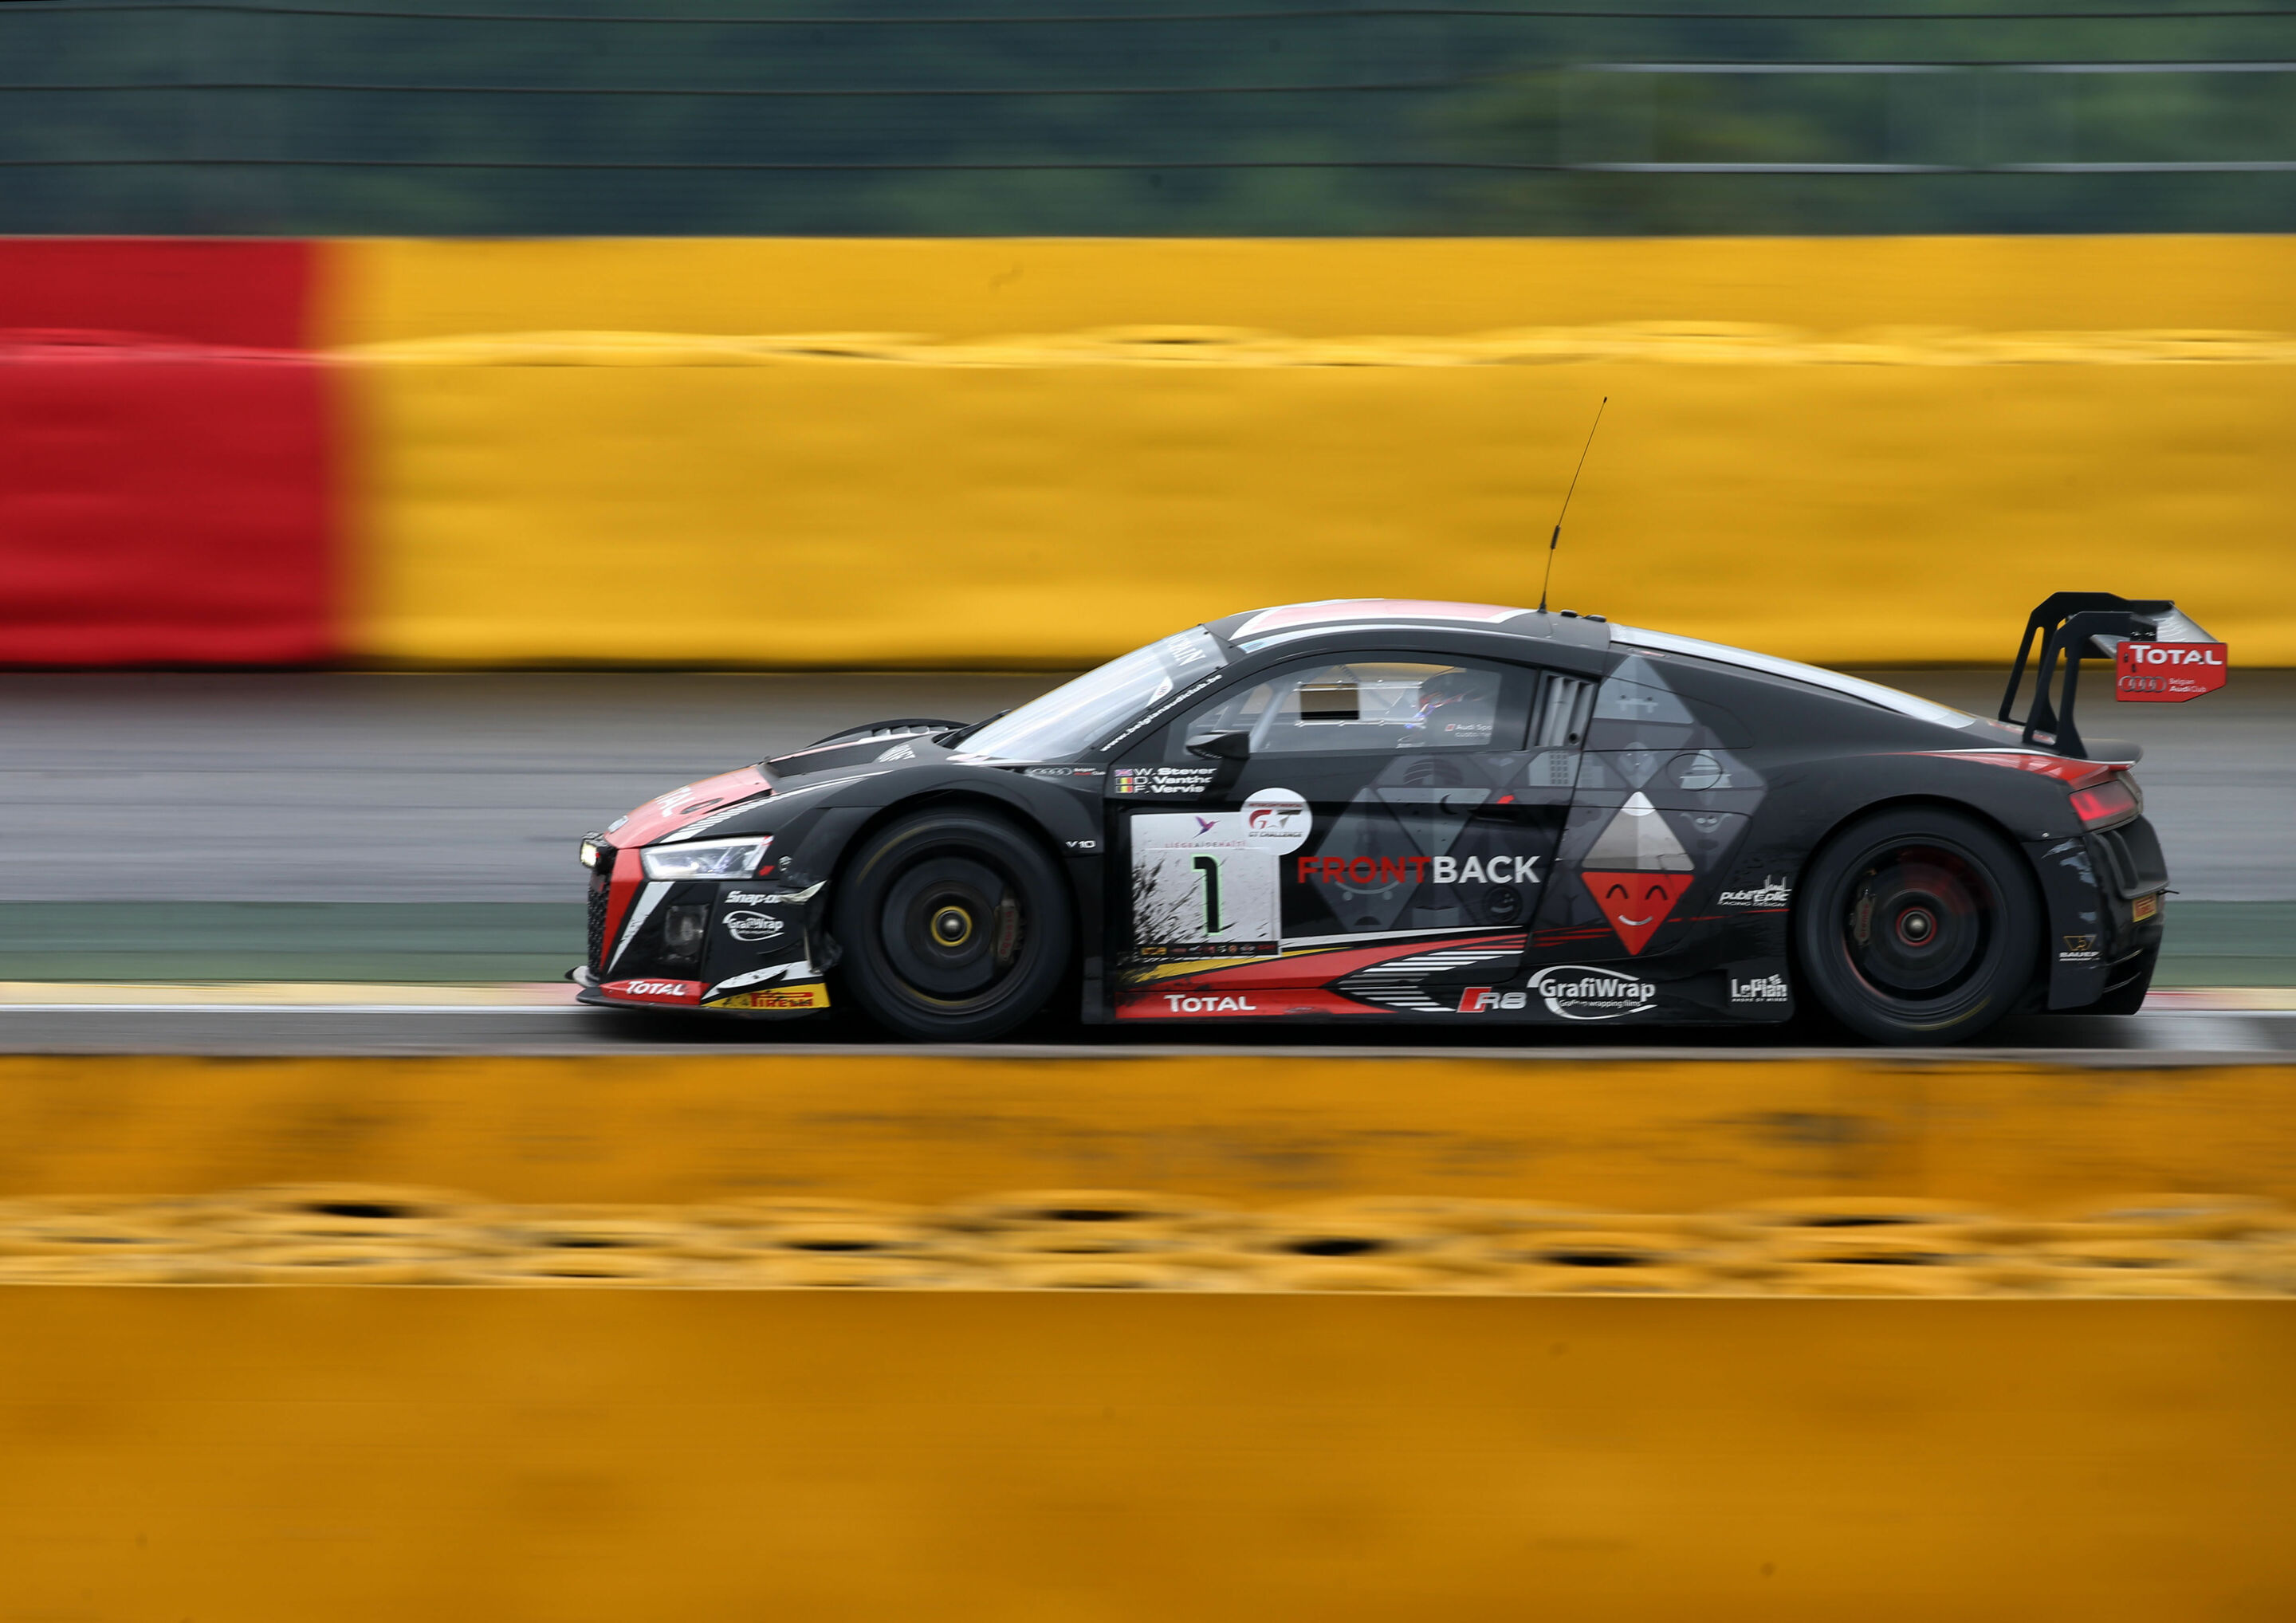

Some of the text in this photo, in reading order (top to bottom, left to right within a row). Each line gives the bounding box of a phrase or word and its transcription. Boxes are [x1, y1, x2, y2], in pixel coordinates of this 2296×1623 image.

[2129, 644, 2223, 665] TOTAL
[1100, 674, 1223, 752] www.belgianaudiclub.be
[1192, 854, 1223, 936] 1
[626, 980, 686, 996] TOTAL
[1539, 977, 1656, 1003] GrafiWrap
[1163, 994, 1256, 1012] TOTAL
[1472, 992, 1527, 1009] R8
[1589, 999, 1622, 1009] wrapping
